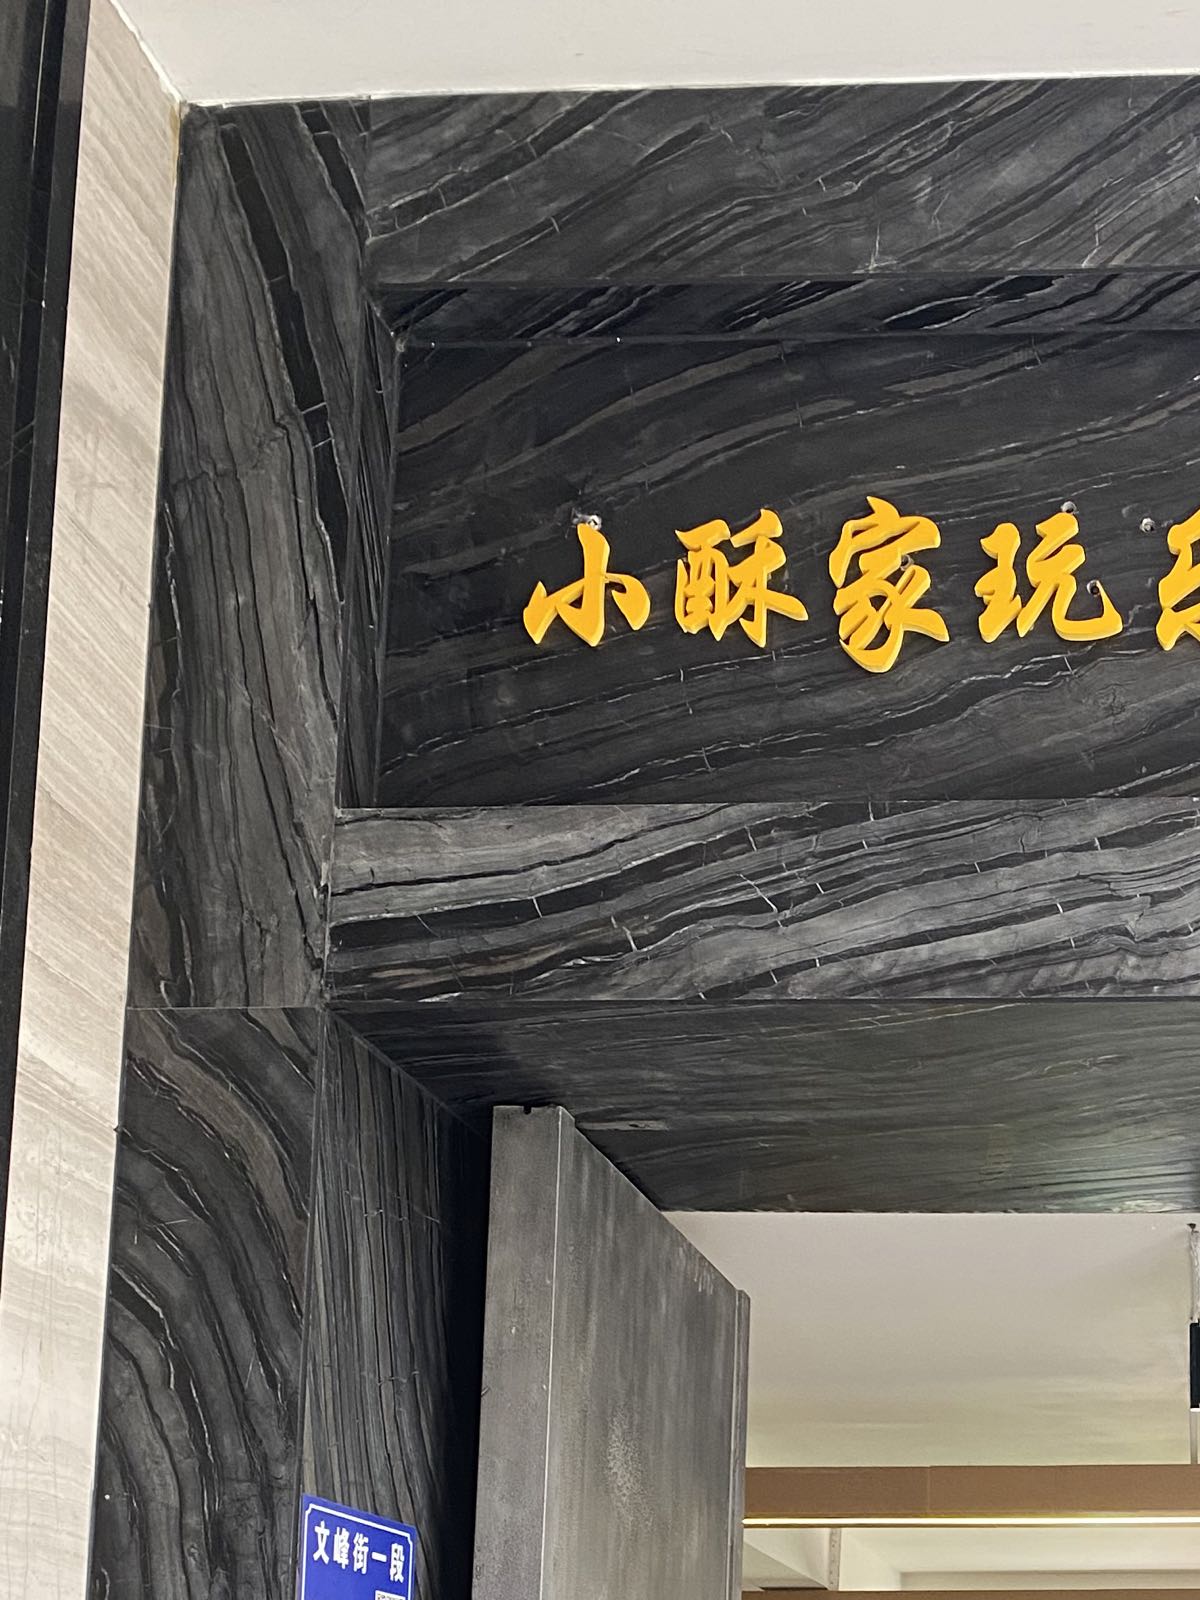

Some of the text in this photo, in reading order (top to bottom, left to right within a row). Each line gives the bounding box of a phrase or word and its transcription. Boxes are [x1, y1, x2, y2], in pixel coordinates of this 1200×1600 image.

[312, 1520, 405, 1584] 文峰街一段
